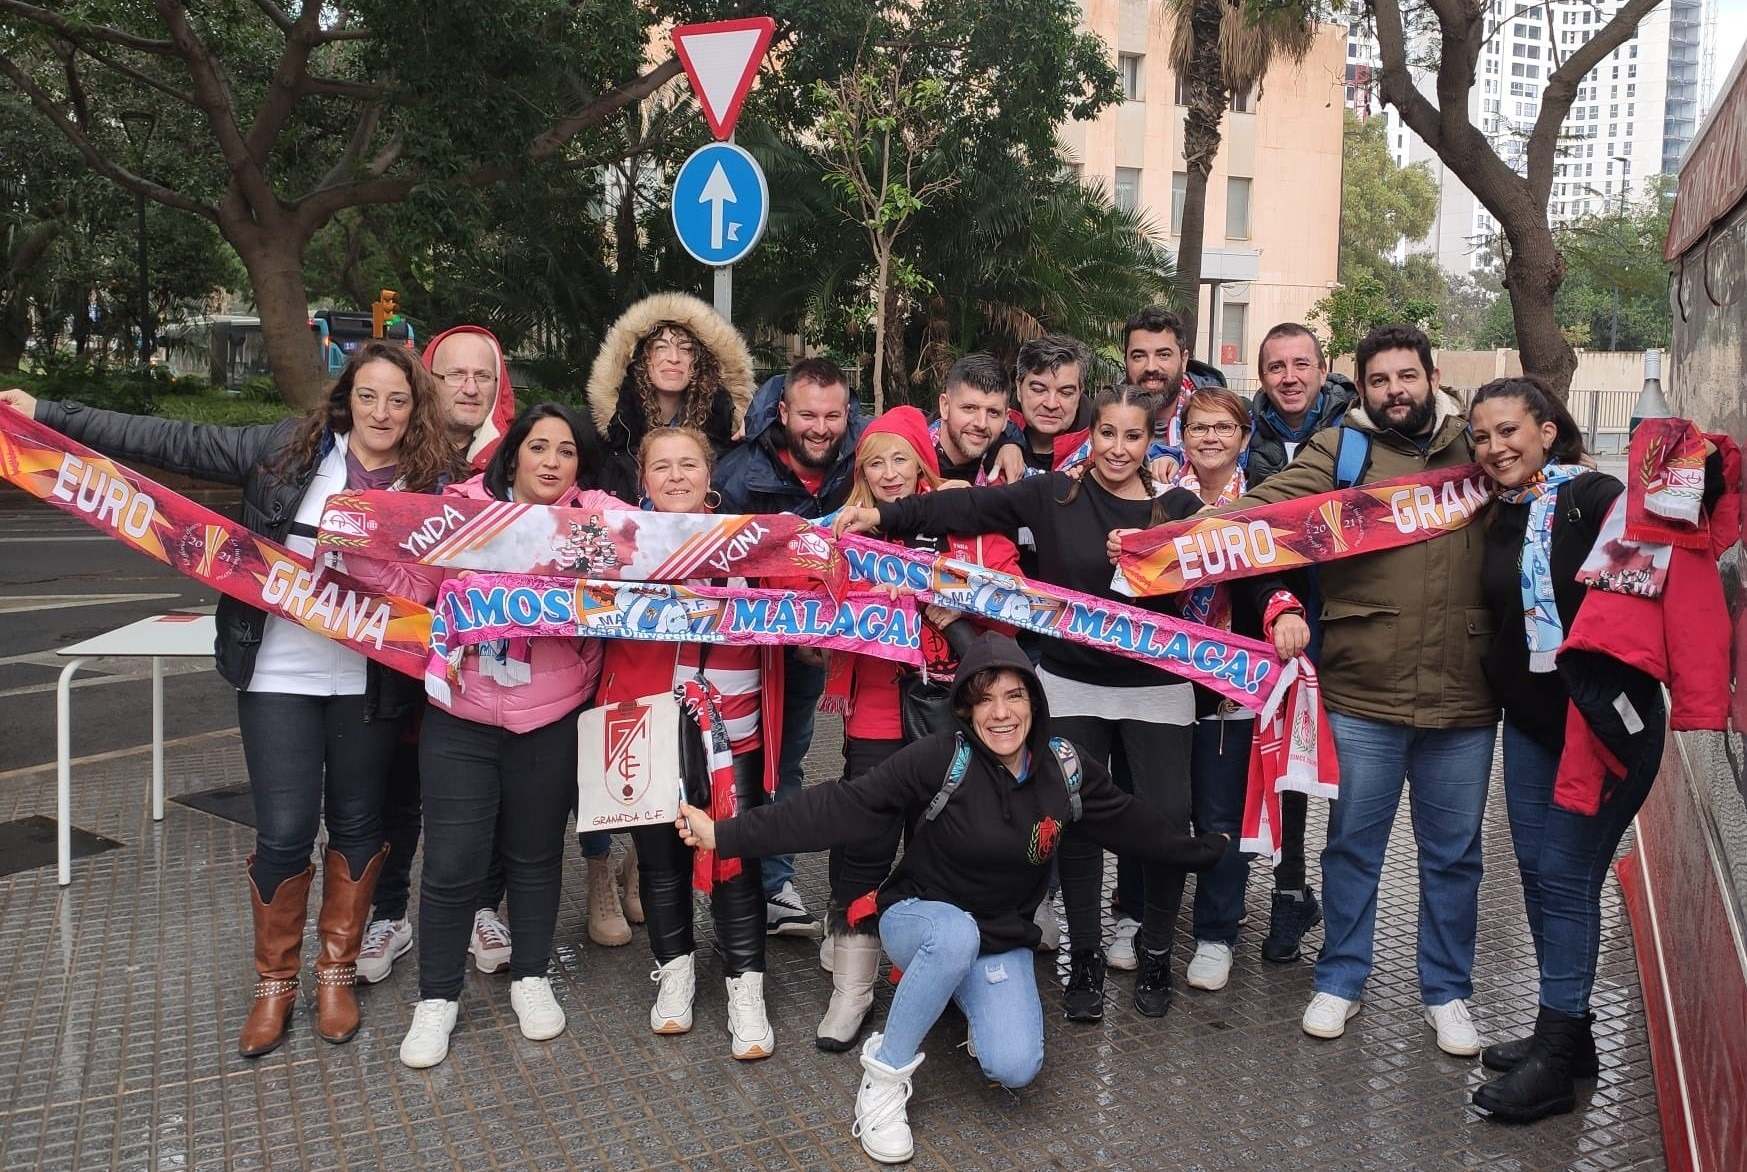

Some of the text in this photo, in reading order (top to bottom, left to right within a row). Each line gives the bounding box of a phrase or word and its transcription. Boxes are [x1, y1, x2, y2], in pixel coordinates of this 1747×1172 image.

[51, 452, 155, 539] EURO
[399, 503, 466, 557] YNDA
[709, 521, 770, 573] YNDA
[1172, 519, 1277, 581] EURO
[729, 591, 922, 649] MÁLAGA!
[592, 812, 640, 826] GRANADA
